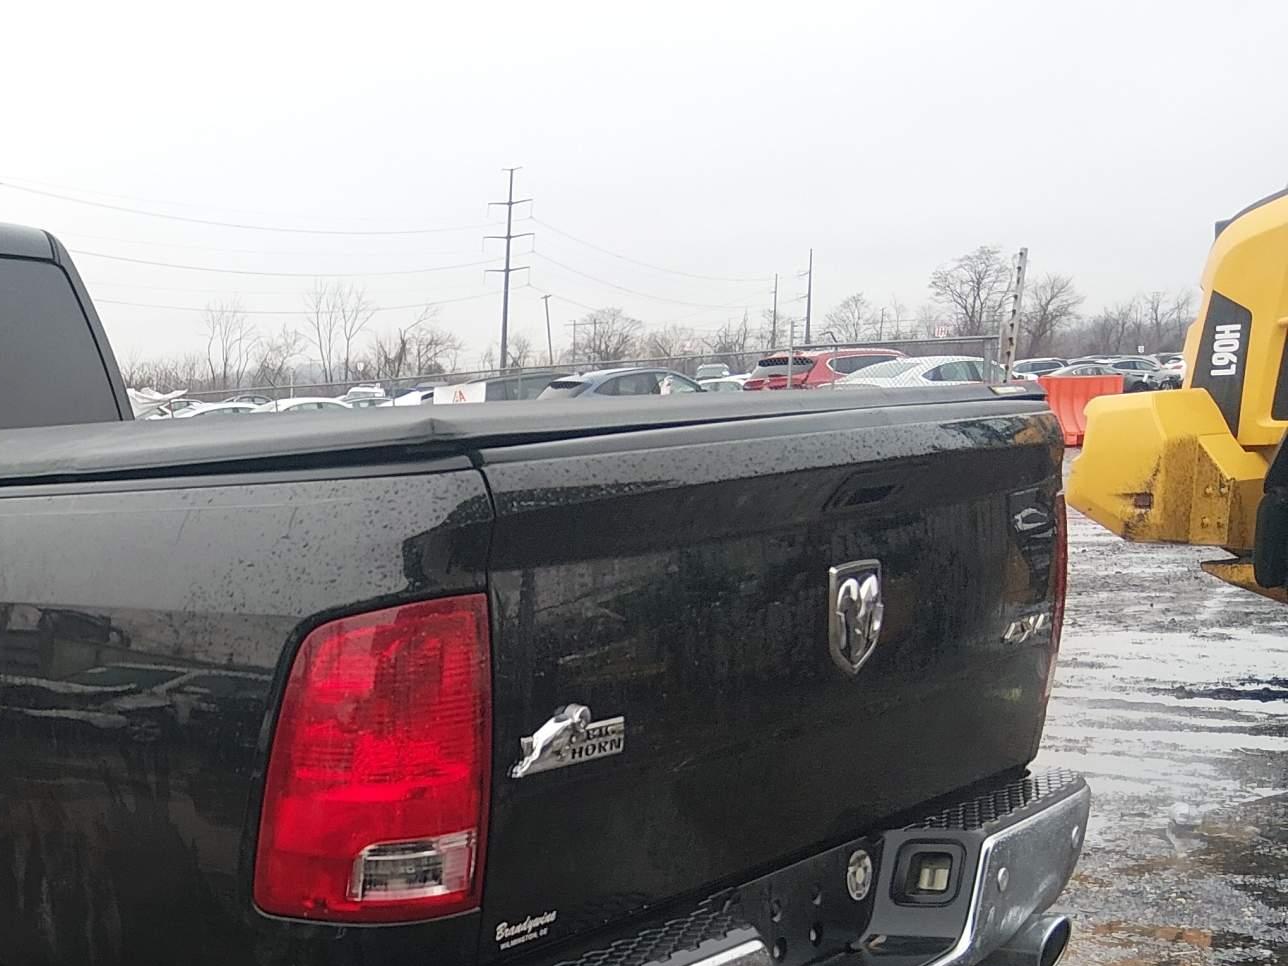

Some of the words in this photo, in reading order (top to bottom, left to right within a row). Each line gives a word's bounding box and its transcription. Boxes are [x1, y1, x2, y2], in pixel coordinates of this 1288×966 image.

[1210, 324, 1242, 376] L90H
[571, 737, 622, 760] HORN
[495, 910, 558, 941] Brandywine
